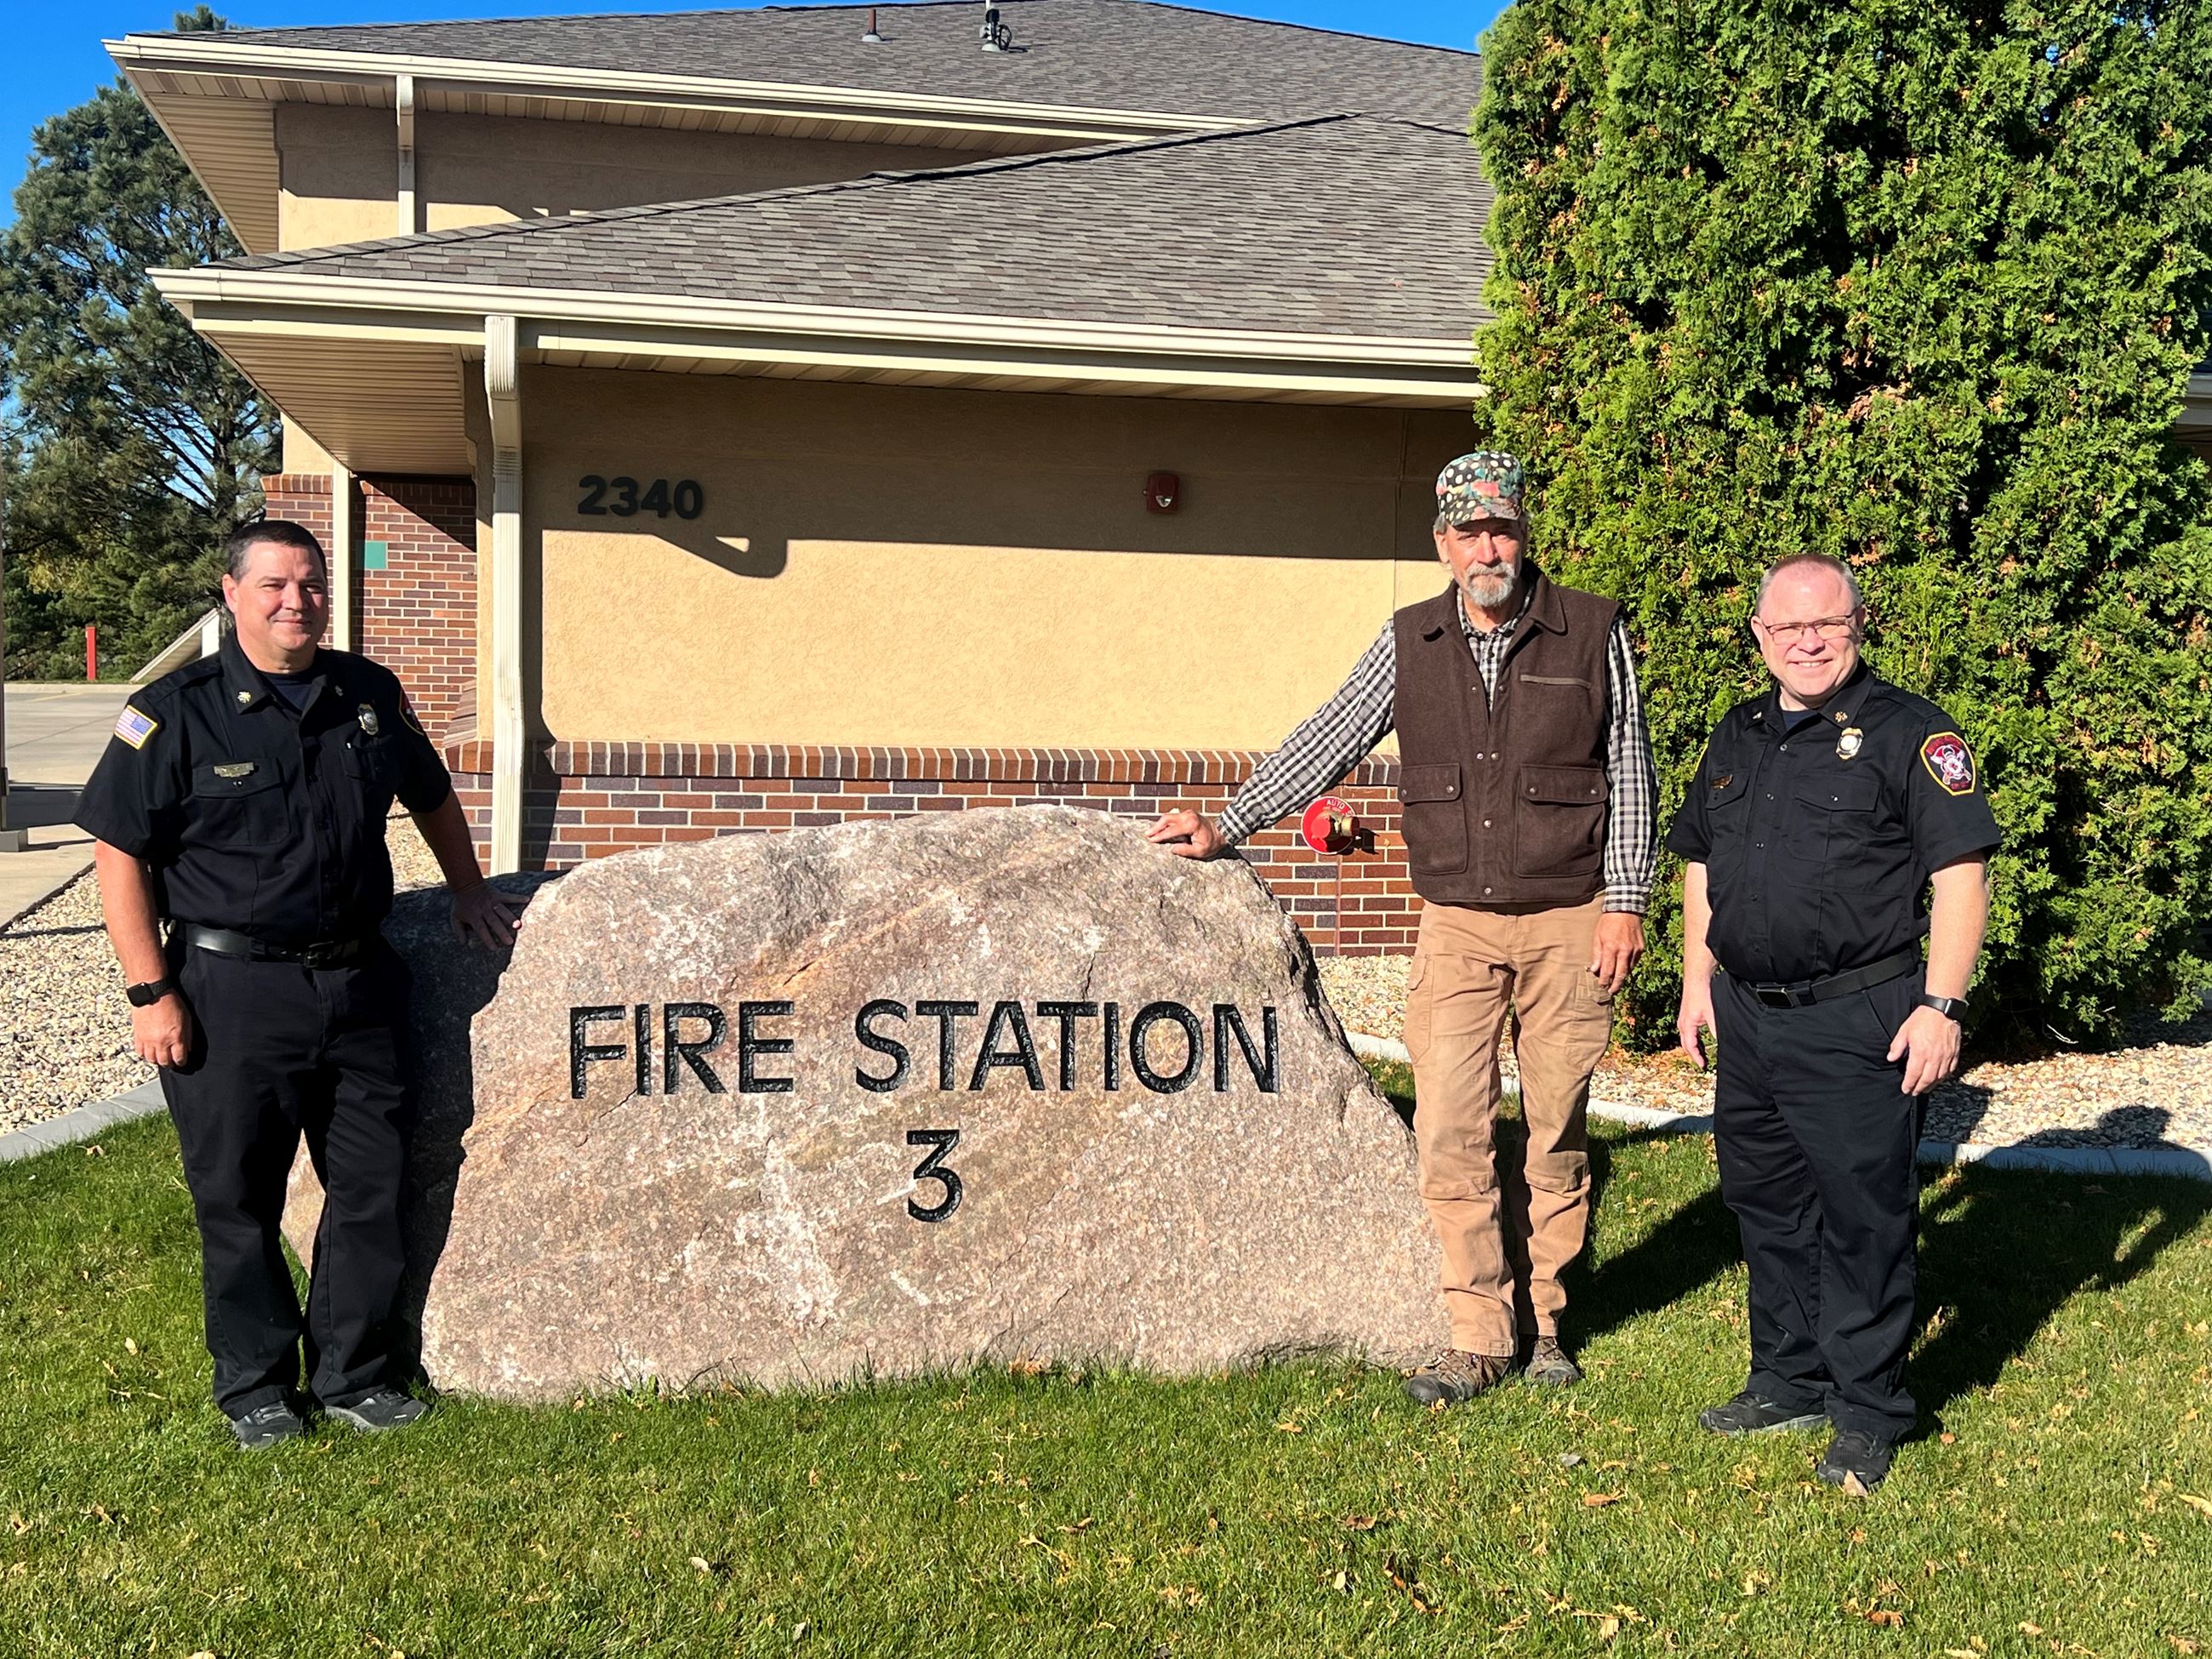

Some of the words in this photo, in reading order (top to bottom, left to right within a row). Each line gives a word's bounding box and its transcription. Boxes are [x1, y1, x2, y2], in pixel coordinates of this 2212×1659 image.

[578, 475, 704, 519] 2340
[1326, 799, 1345, 810] AUTO
[569, 1001, 795, 1099] FIRE
[854, 999, 1280, 1093] STATION
[907, 1129, 961, 1223] 3
